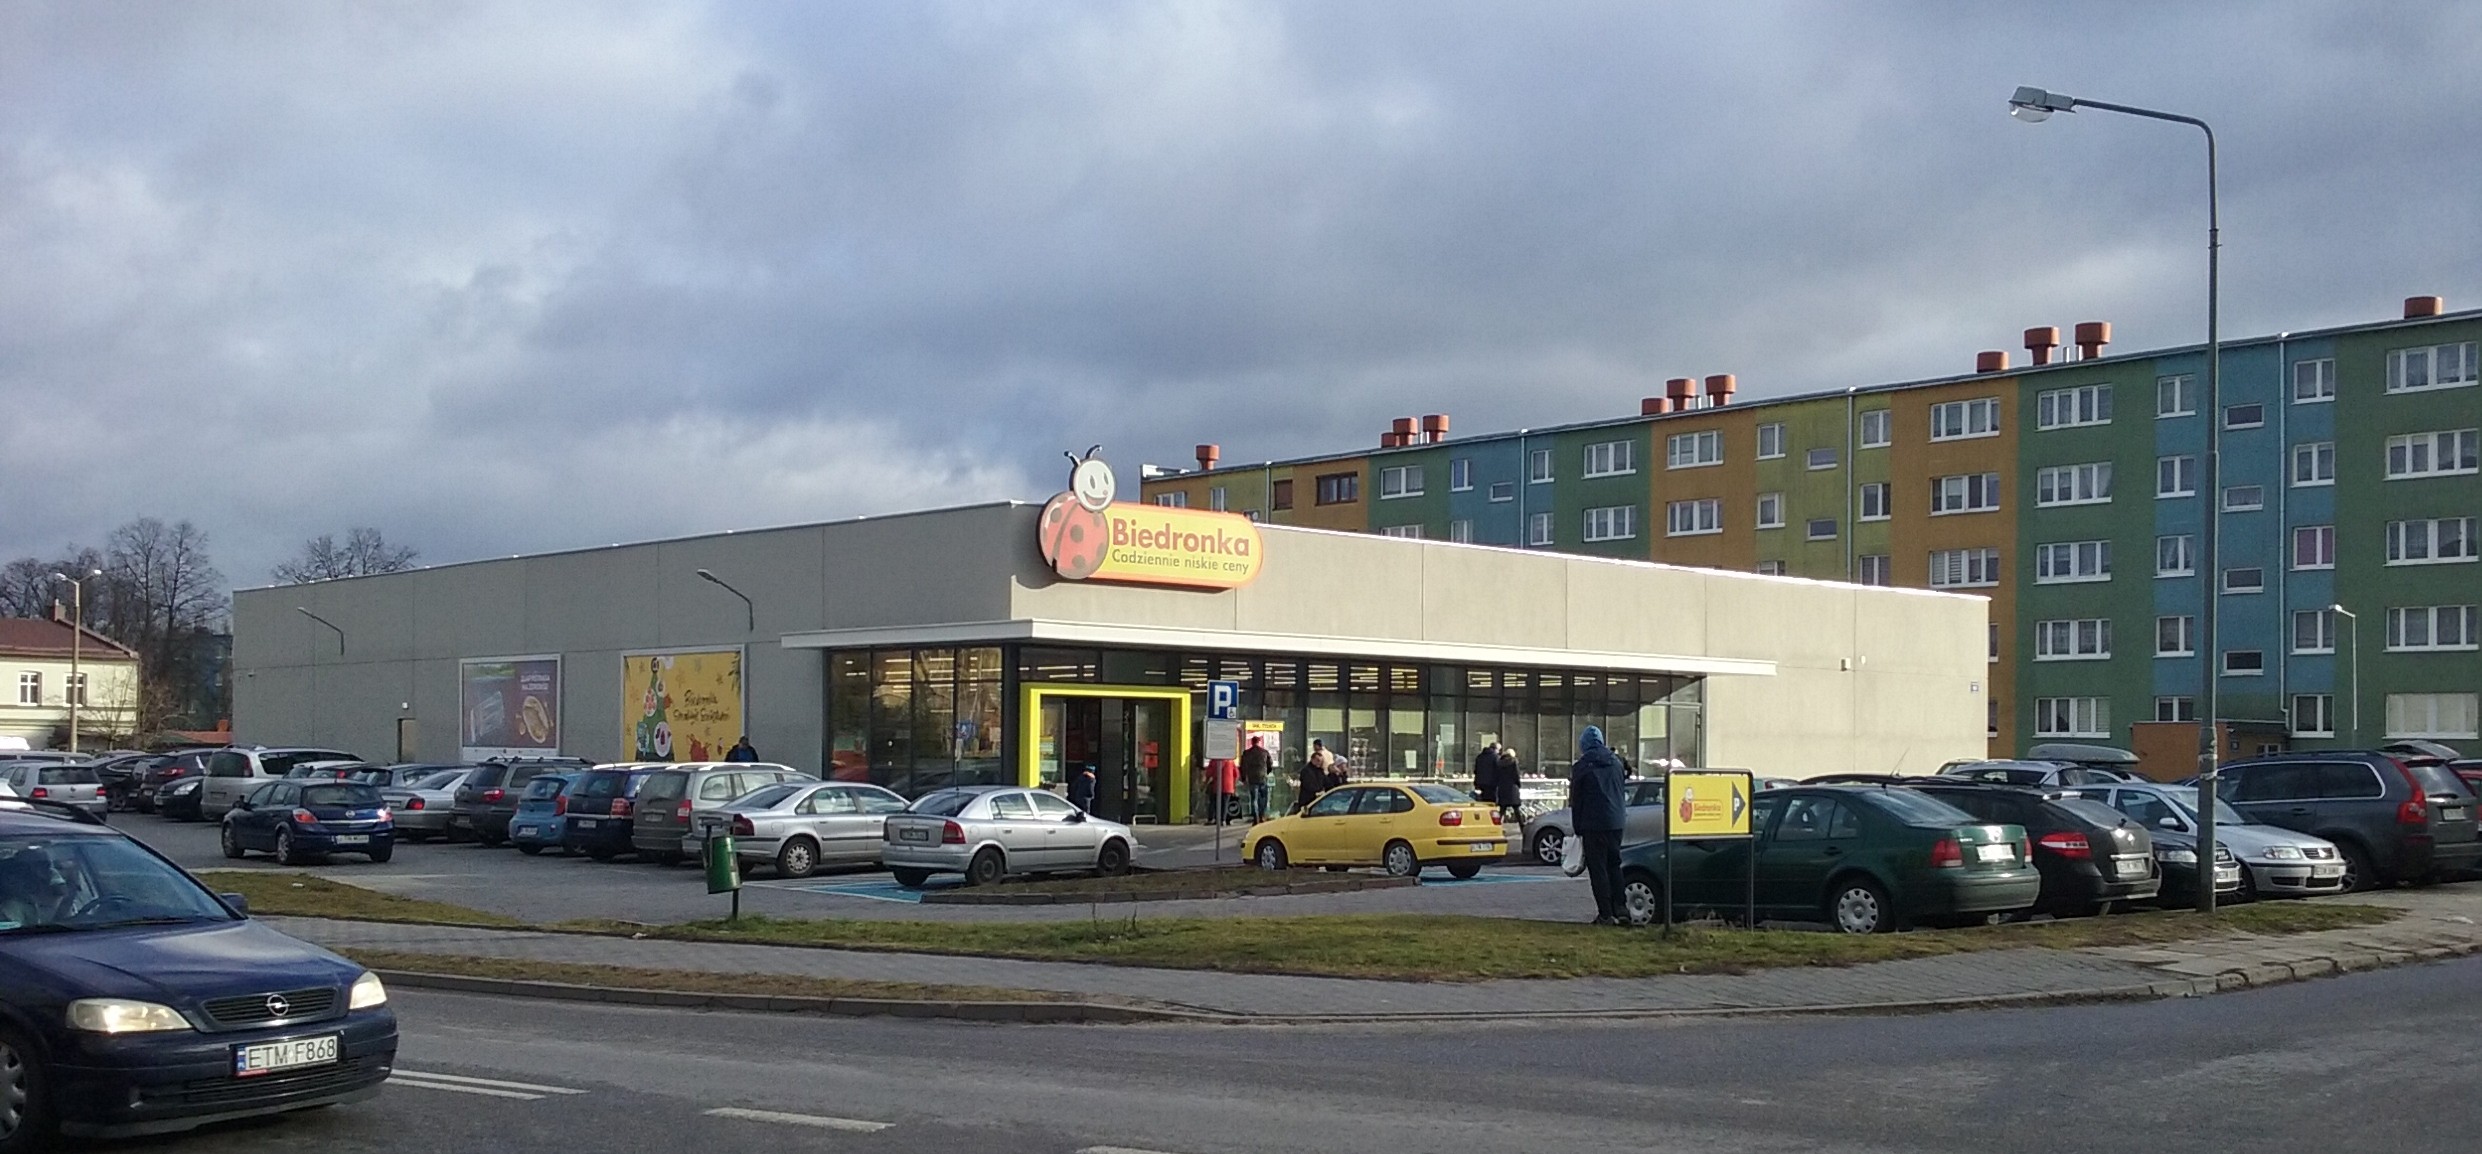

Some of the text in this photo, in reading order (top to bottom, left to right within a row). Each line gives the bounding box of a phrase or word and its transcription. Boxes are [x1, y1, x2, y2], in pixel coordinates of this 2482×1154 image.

[1112, 517, 1249, 557] Biedronka
[1111, 548, 1249, 575] Codziennie niskie ceny
[1214, 685, 1232, 715] P
[1733, 797, 1741, 812] P
[248, 1038, 336, 1069] ETM F868
